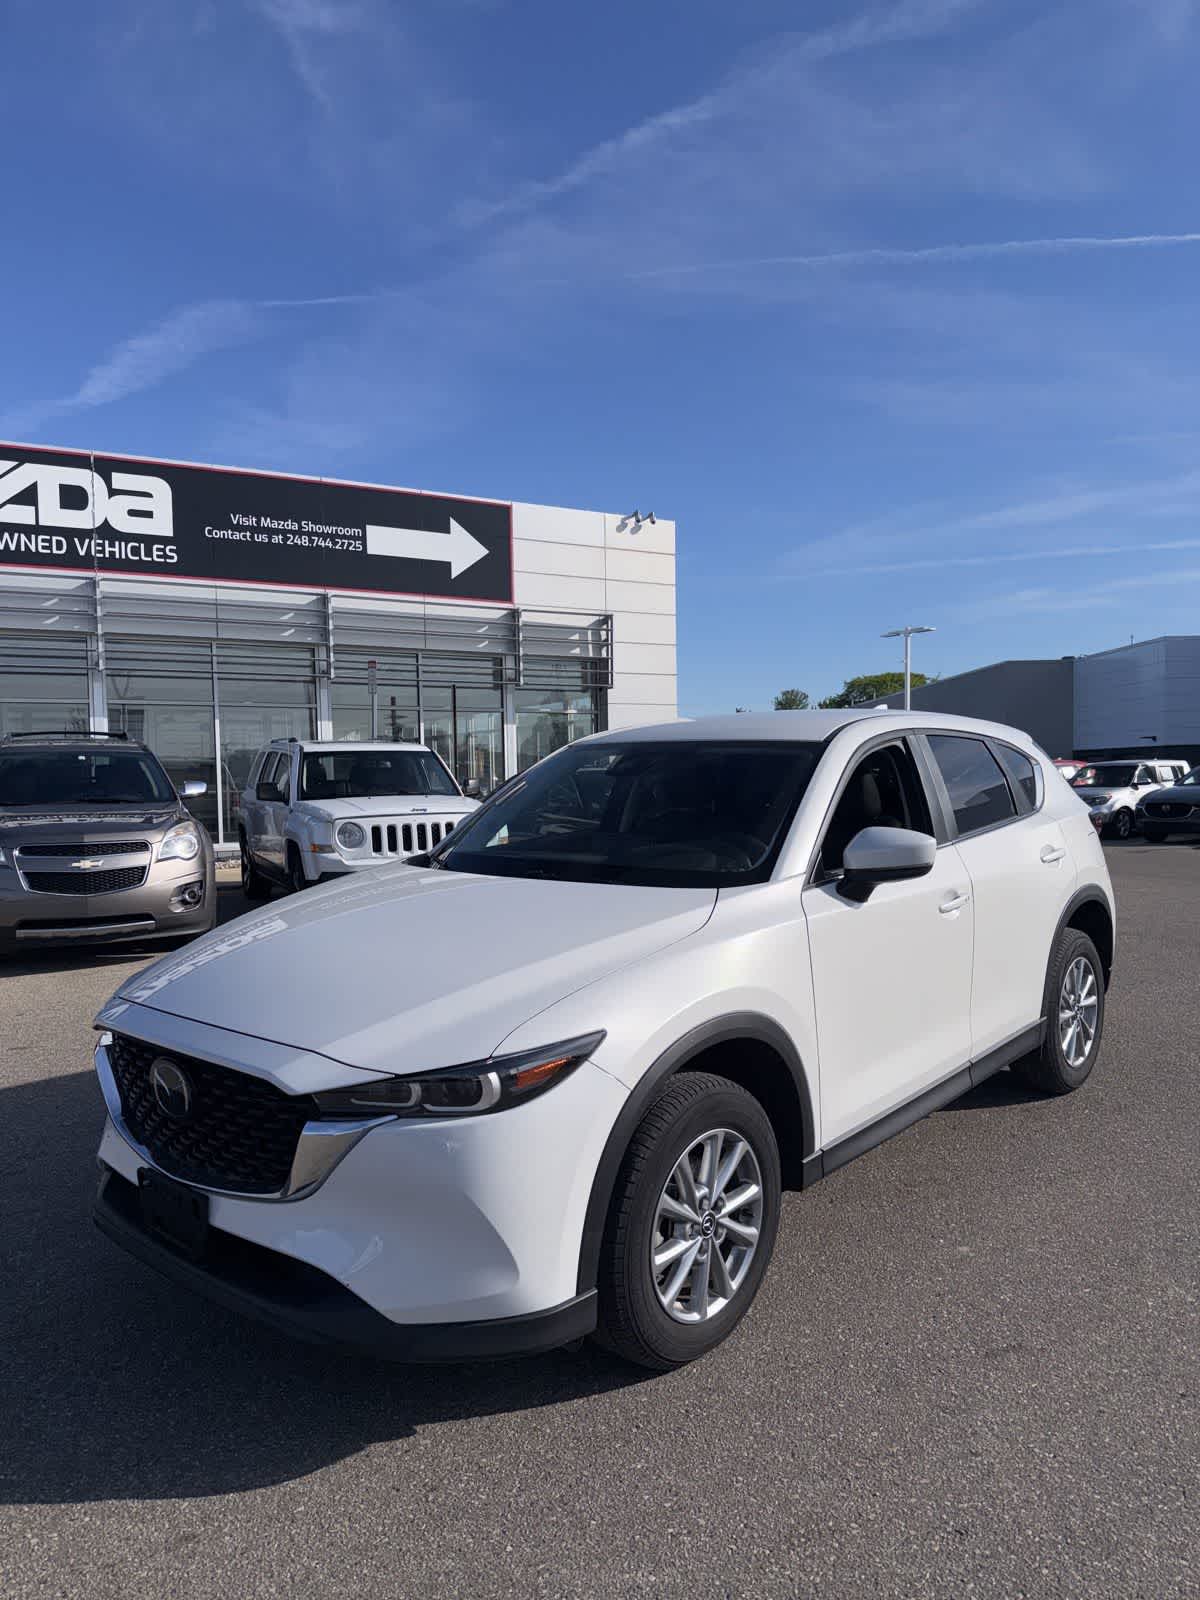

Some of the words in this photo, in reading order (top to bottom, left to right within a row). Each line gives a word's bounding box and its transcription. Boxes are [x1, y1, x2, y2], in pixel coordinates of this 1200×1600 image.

[230, 513, 257, 526] Visit
[260, 517, 299, 530] Mazda
[301, 521, 362, 537] Showroom
[74, 537, 178, 563] VEHICLES
[204, 526, 251, 541] Contact
[254, 533, 269, 542] us
[271, 534, 284, 544] at
[286, 534, 363, 551] 248.744.2725
